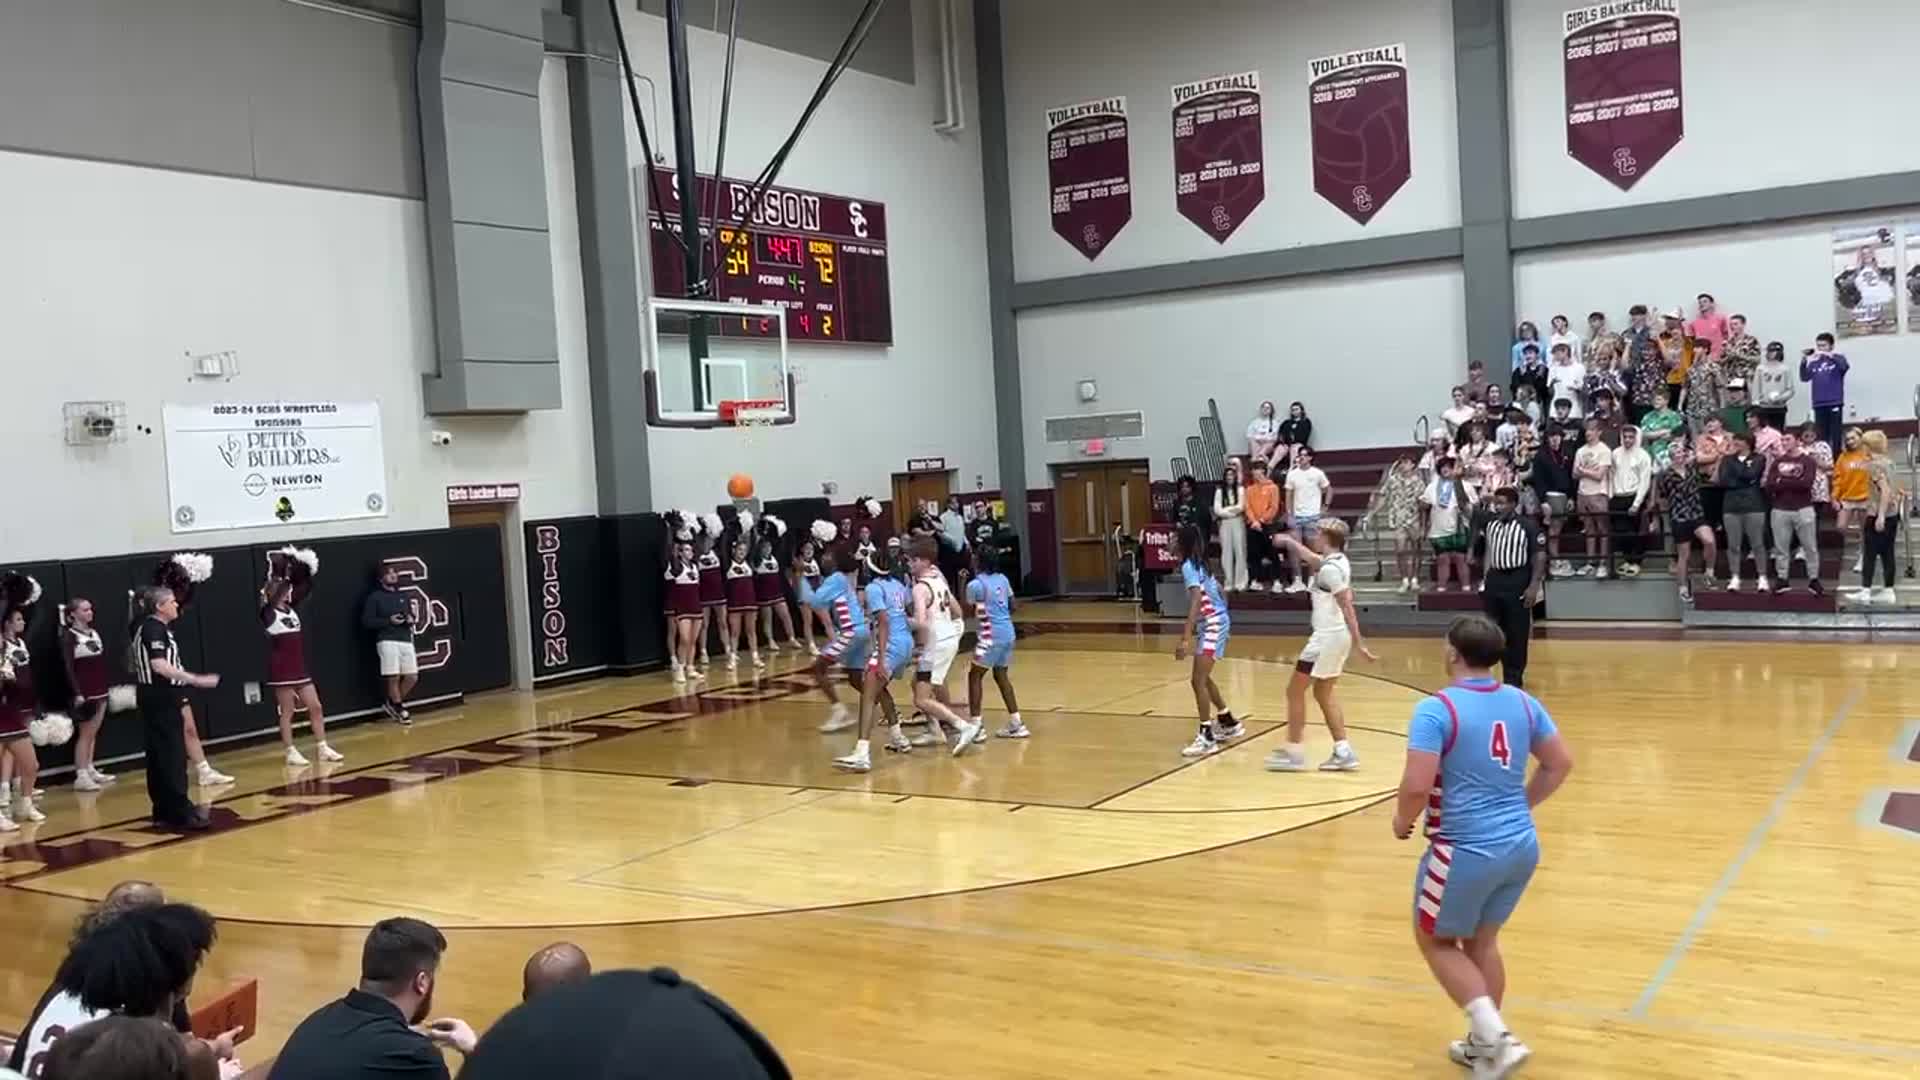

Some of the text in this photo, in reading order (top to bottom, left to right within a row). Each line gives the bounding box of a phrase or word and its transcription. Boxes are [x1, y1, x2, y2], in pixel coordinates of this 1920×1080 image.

[1567, 0, 1676, 32] GIRLS BASKETBALL
[1594, 40, 1620, 55] 2007
[1311, 46, 1403, 77] VOLLEYBALL
[1173, 74, 1257, 102] VOLLEYBALL
[1048, 99, 1125, 126] VOLLEYBALL
[1597, 106, 1622, 120] 2007
[730, 183, 820, 231] BISON
[849, 202, 868, 238] SC
[727, 248, 749, 275] 54
[813, 256, 833, 283] 72
[758, 274, 785, 287] PERIOD
[822, 316, 833, 335] 2
[254, 419, 302, 427] SPONSORS
[247, 429, 306, 448] PETTIS
[248, 448, 330, 468] BUILDERS
[271, 473, 323, 486] NEWTON
[536, 525, 569, 667] BISON
[1488, 720, 1512, 770] 4
